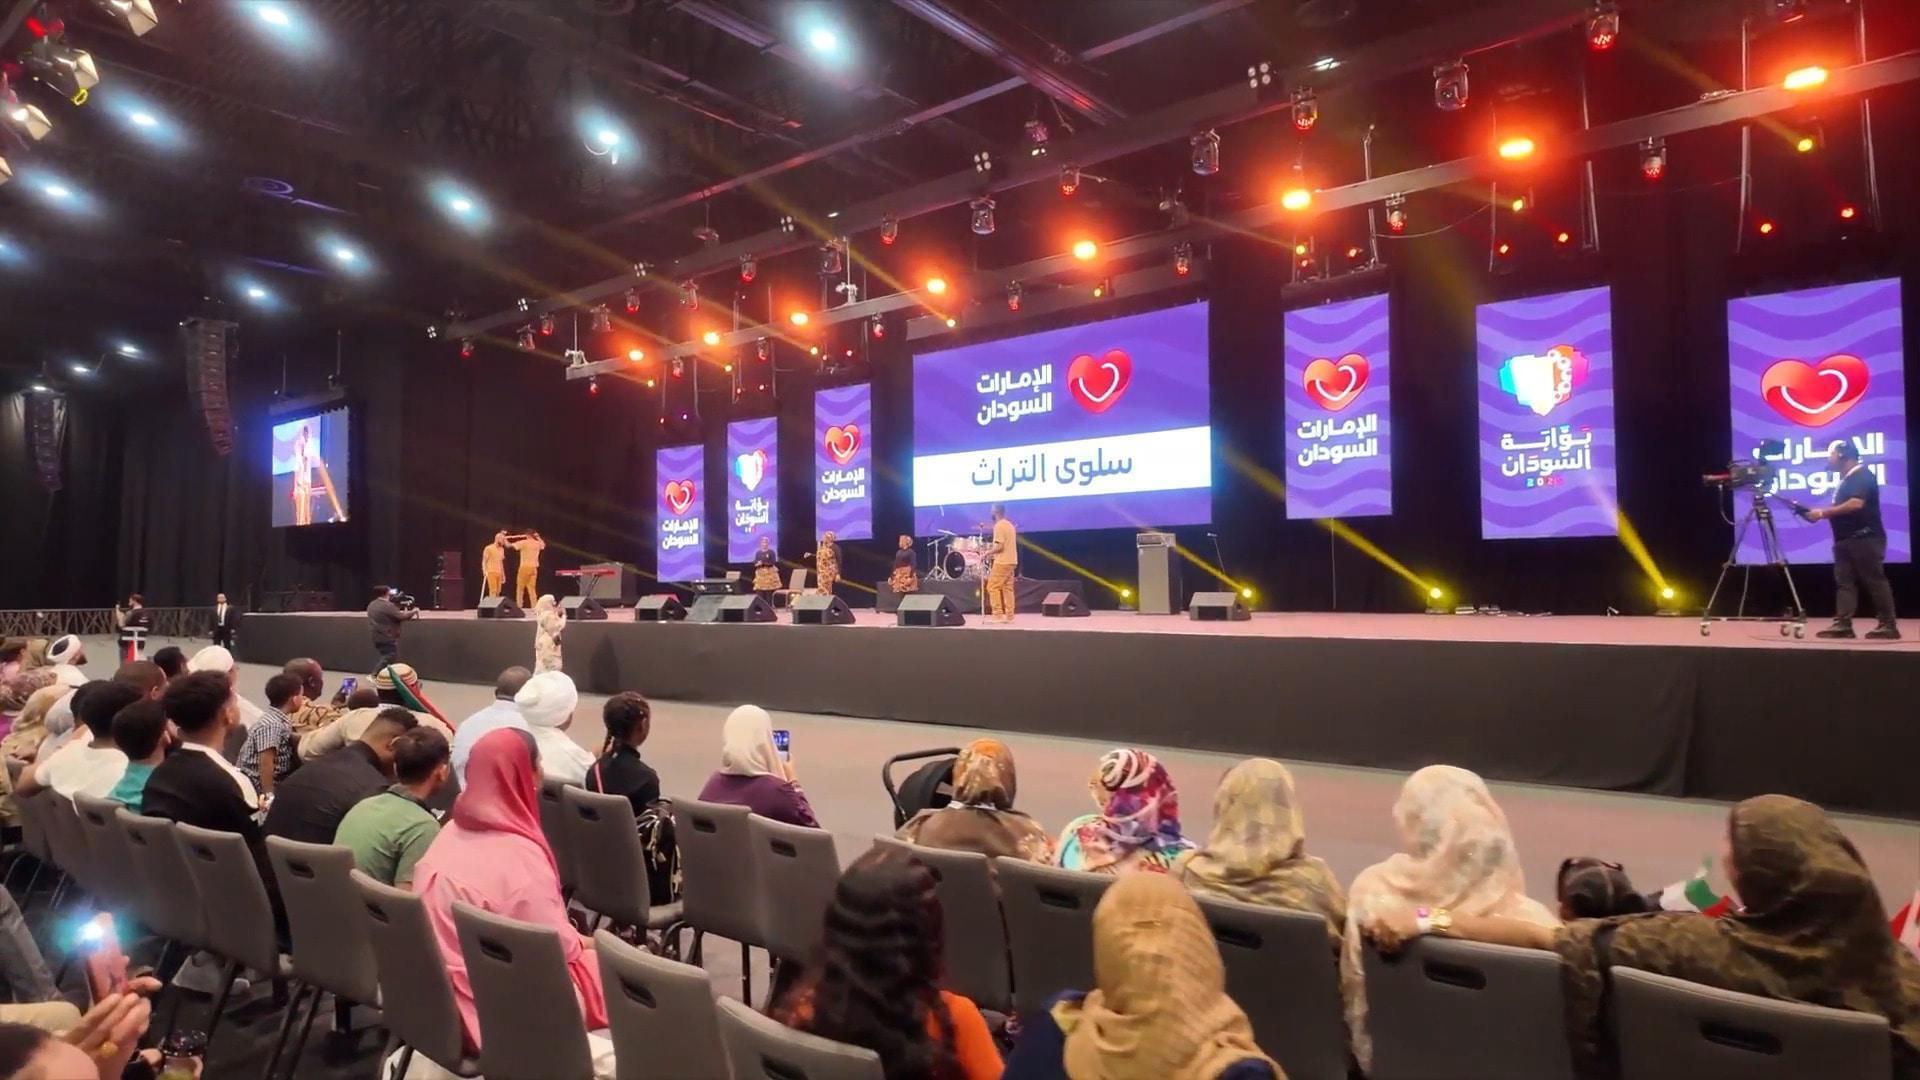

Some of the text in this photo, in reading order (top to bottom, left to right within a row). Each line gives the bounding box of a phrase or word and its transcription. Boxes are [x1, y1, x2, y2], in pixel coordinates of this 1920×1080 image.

[977, 363, 1052, 393] الإمارات
[977, 392, 1052, 426] السودان
[1297, 413, 1378, 439] الإمارات
[1297, 438, 1378, 467] السودان
[971, 447, 1133, 492] سلوى التراث
[821, 484, 865, 504] السودان
